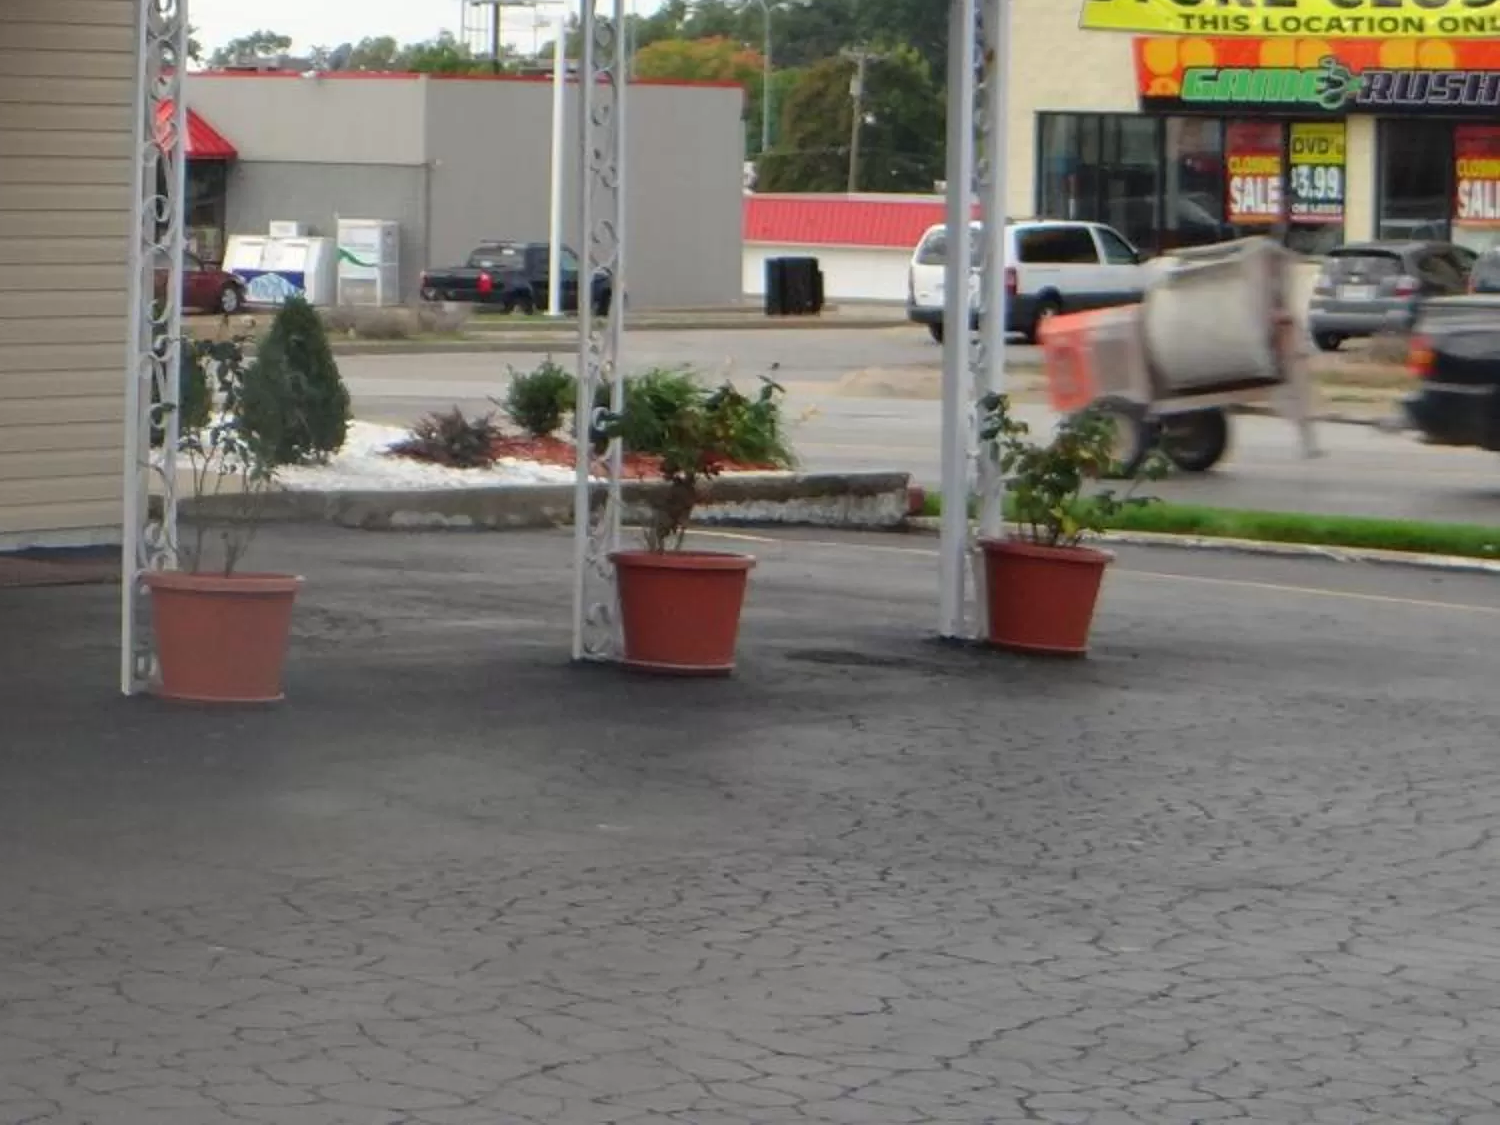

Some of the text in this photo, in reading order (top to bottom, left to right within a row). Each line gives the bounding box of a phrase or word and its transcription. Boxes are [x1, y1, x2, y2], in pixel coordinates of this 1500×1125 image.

[1178, 13, 1250, 31] THIS
[1262, 15, 1424, 34] LOCATION
[1356, 71, 1500, 105] RUSH
[1230, 176, 1281, 213] SALE
